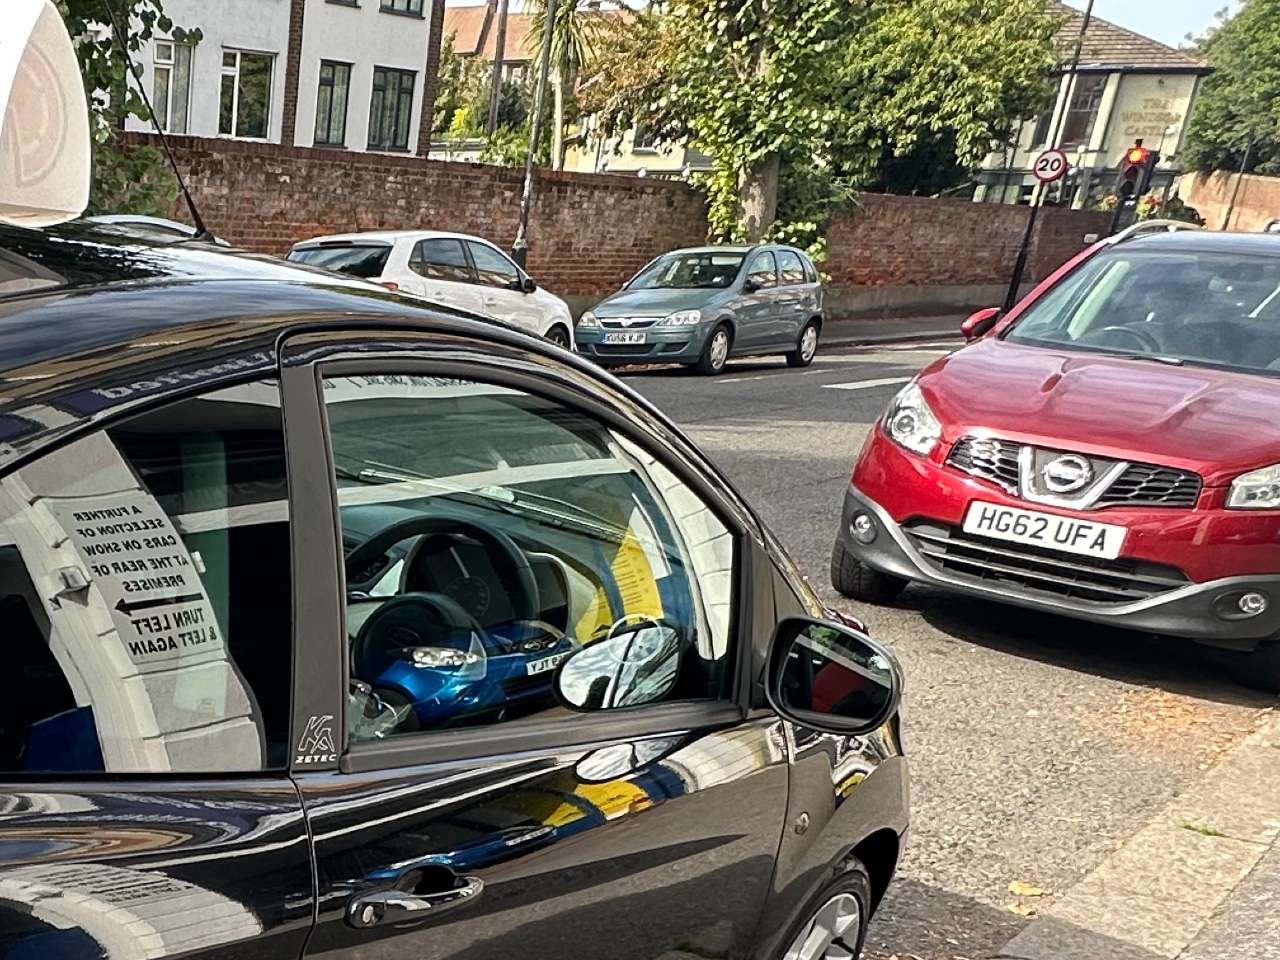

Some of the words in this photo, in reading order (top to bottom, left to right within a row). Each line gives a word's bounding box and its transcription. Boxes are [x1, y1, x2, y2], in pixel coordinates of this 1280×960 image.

[1037, 157, 1060, 172] 20
[976, 506, 1050, 540] HG62
[1054, 522, 1108, 552] UFA
[295, 754, 337, 764] ZETEC
